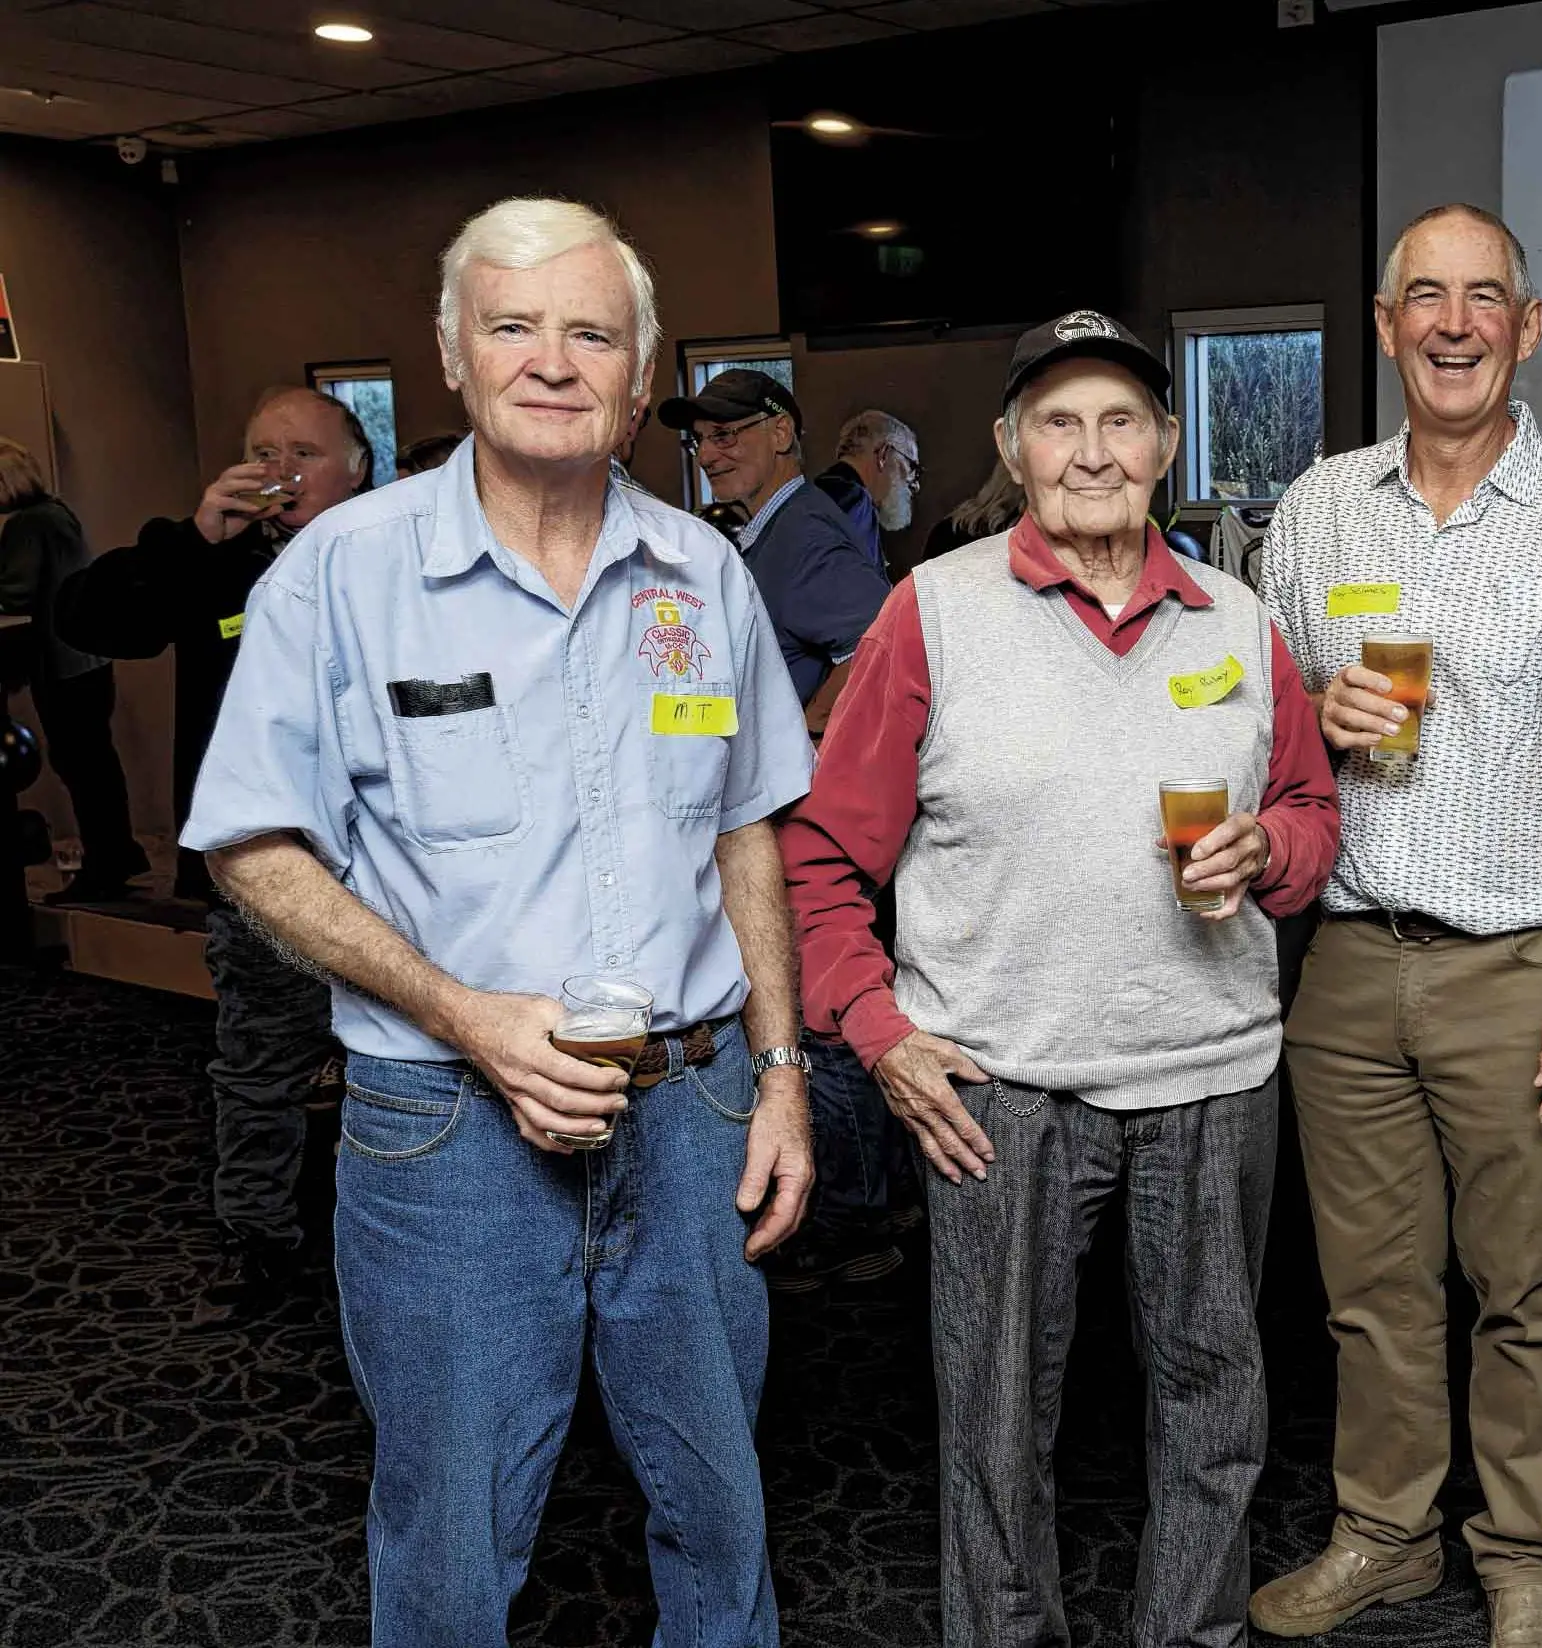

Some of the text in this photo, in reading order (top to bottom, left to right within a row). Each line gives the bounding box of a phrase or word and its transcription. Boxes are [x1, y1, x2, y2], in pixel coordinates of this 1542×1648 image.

[632, 587, 706, 610] CENTRAL WEST
[651, 627, 691, 640] CLASSIC
